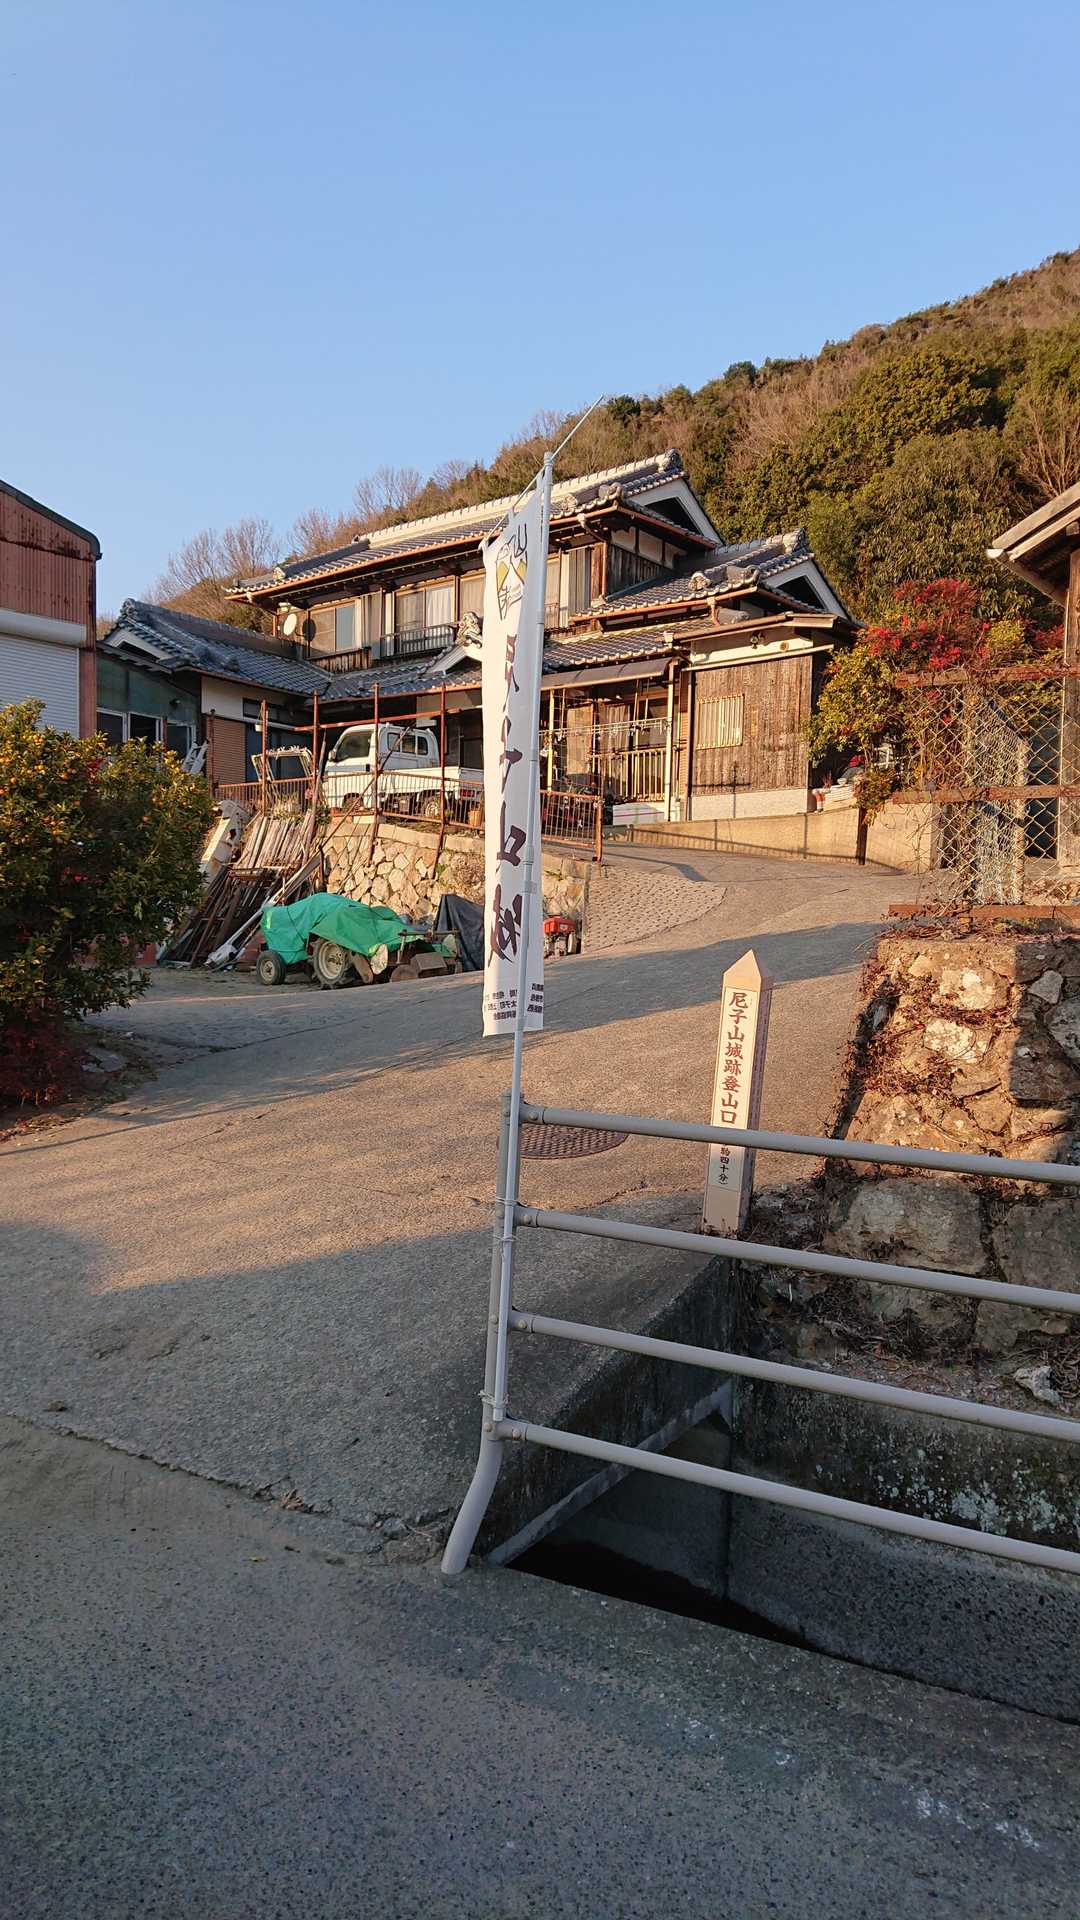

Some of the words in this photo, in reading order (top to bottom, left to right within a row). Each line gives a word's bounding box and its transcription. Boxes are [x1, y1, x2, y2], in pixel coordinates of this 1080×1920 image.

[719, 991, 749, 1125] 尼子山城跡登山口
